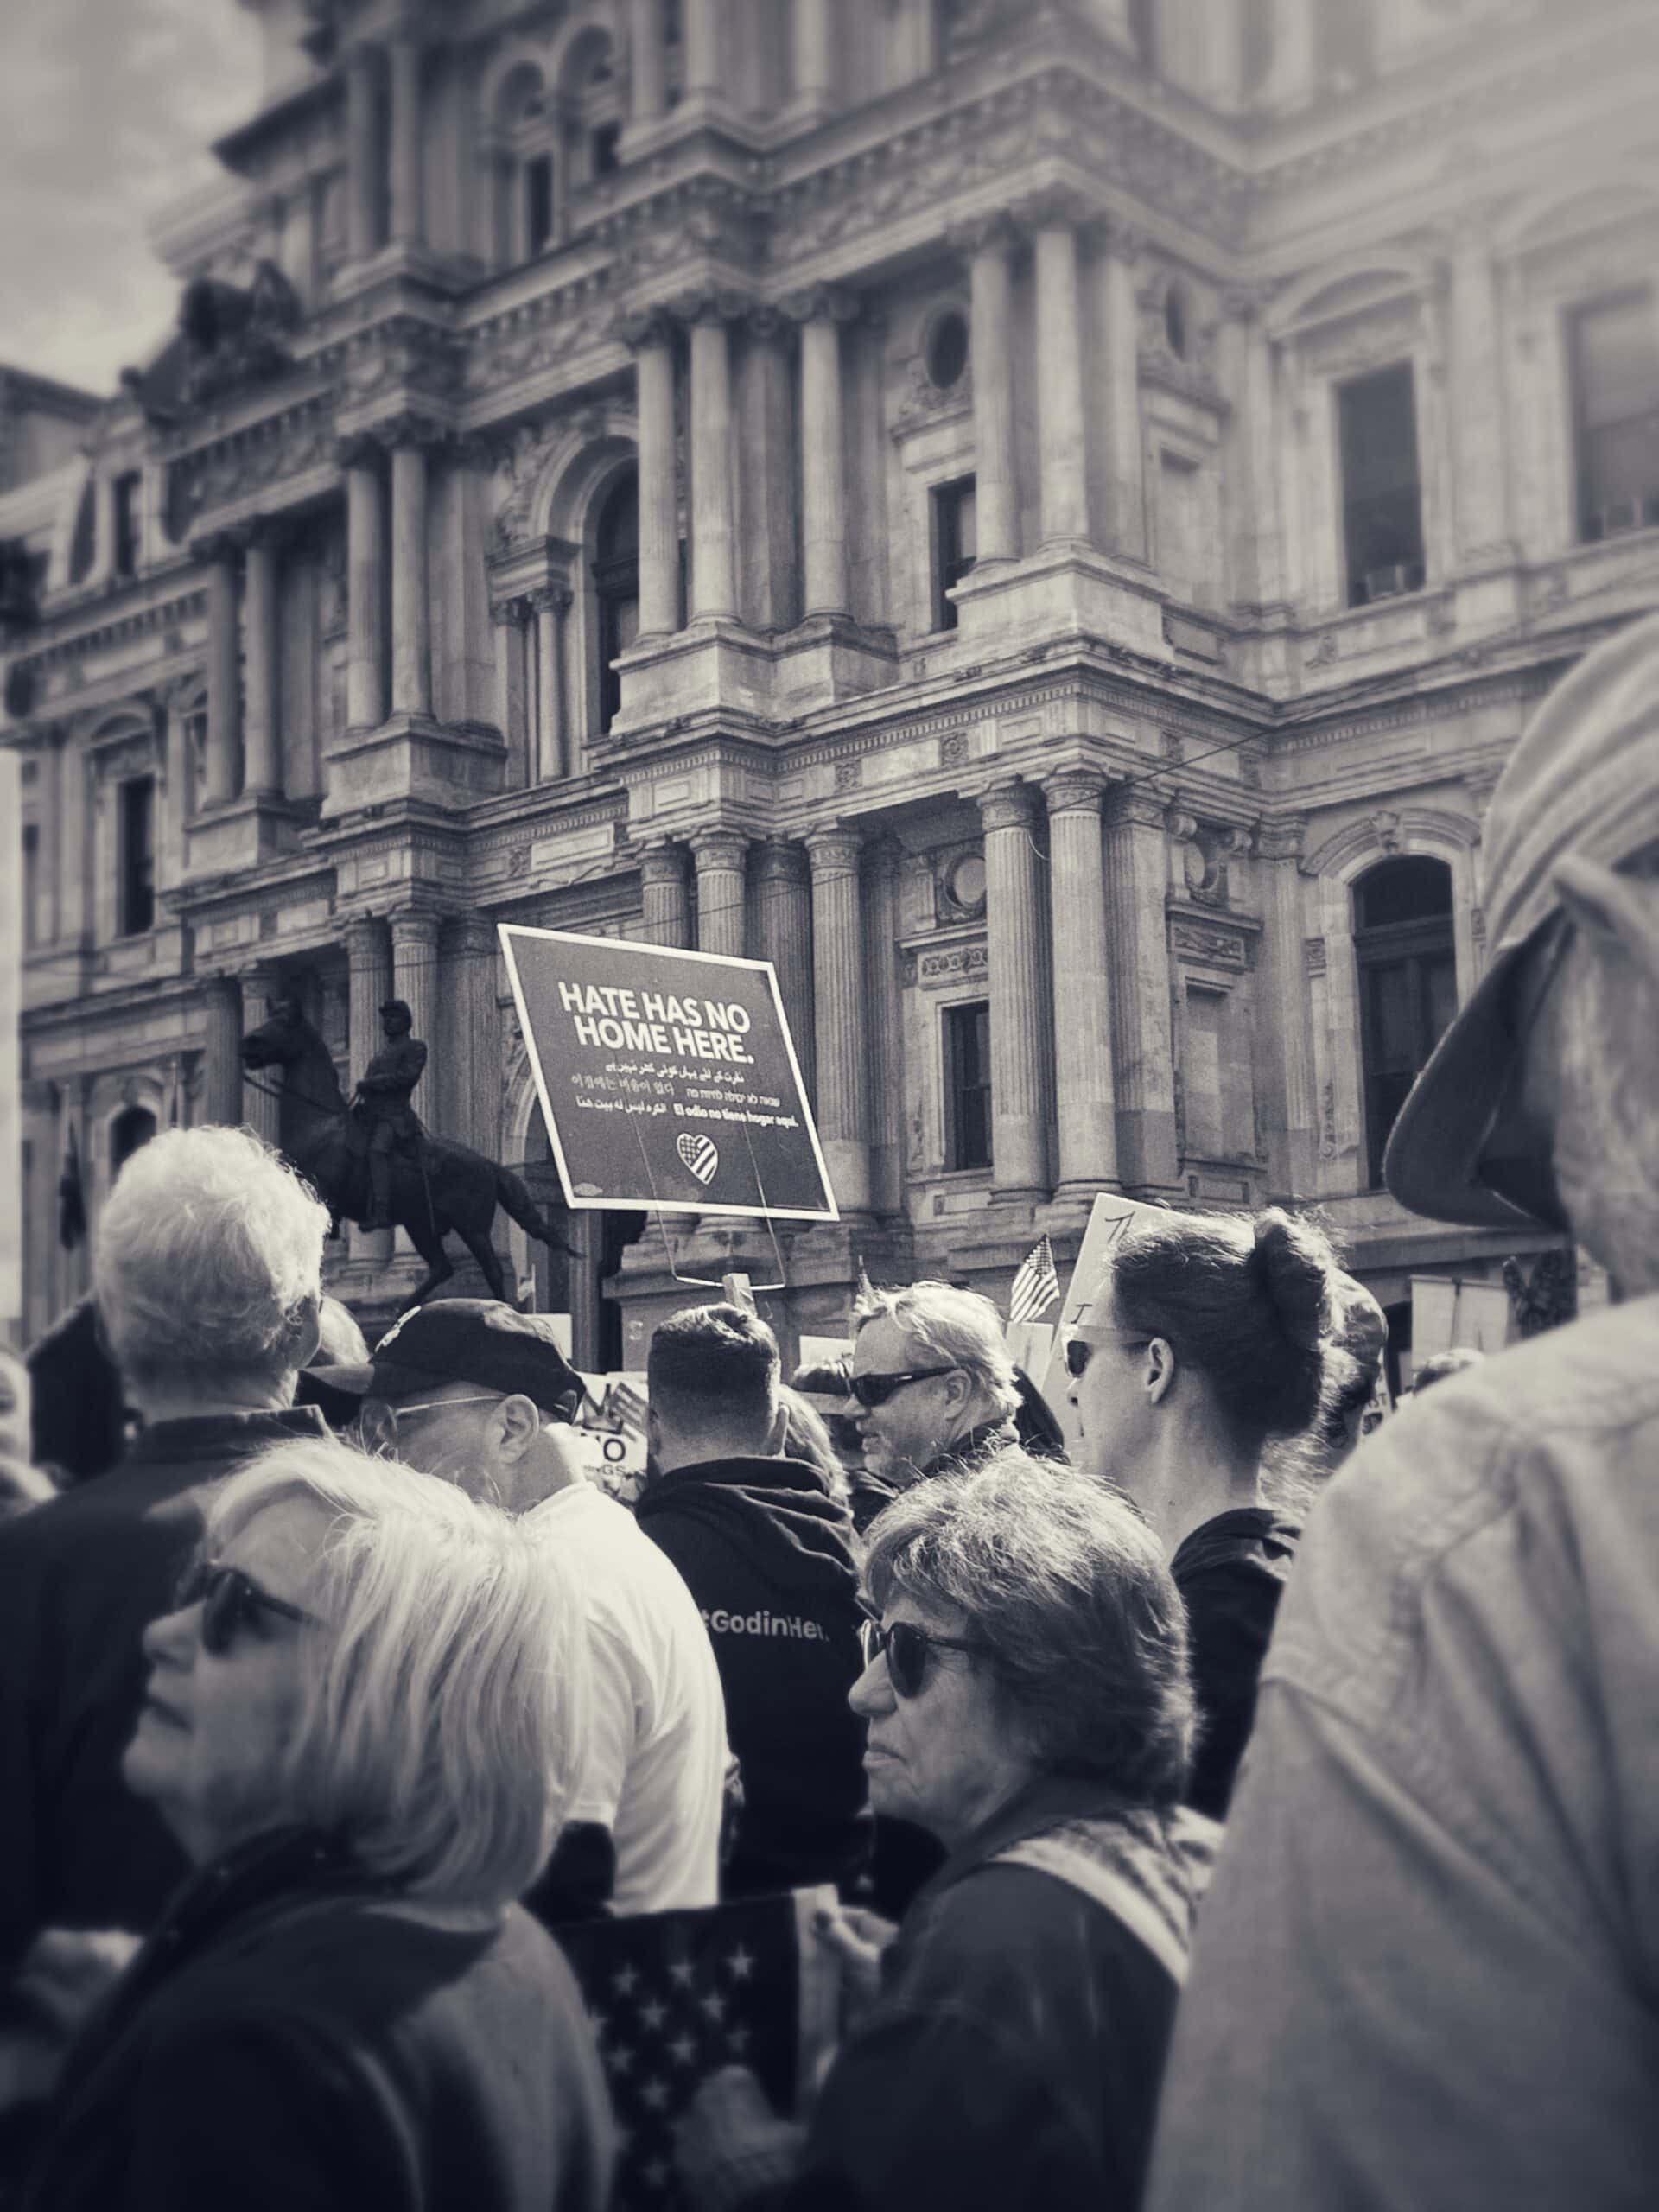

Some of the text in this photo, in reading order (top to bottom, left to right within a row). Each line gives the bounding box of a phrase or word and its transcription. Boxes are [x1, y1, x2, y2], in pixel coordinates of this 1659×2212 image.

[557, 981, 751, 1033] HATE HAS NO
[573, 1014, 755, 1064] HOME HERE.
